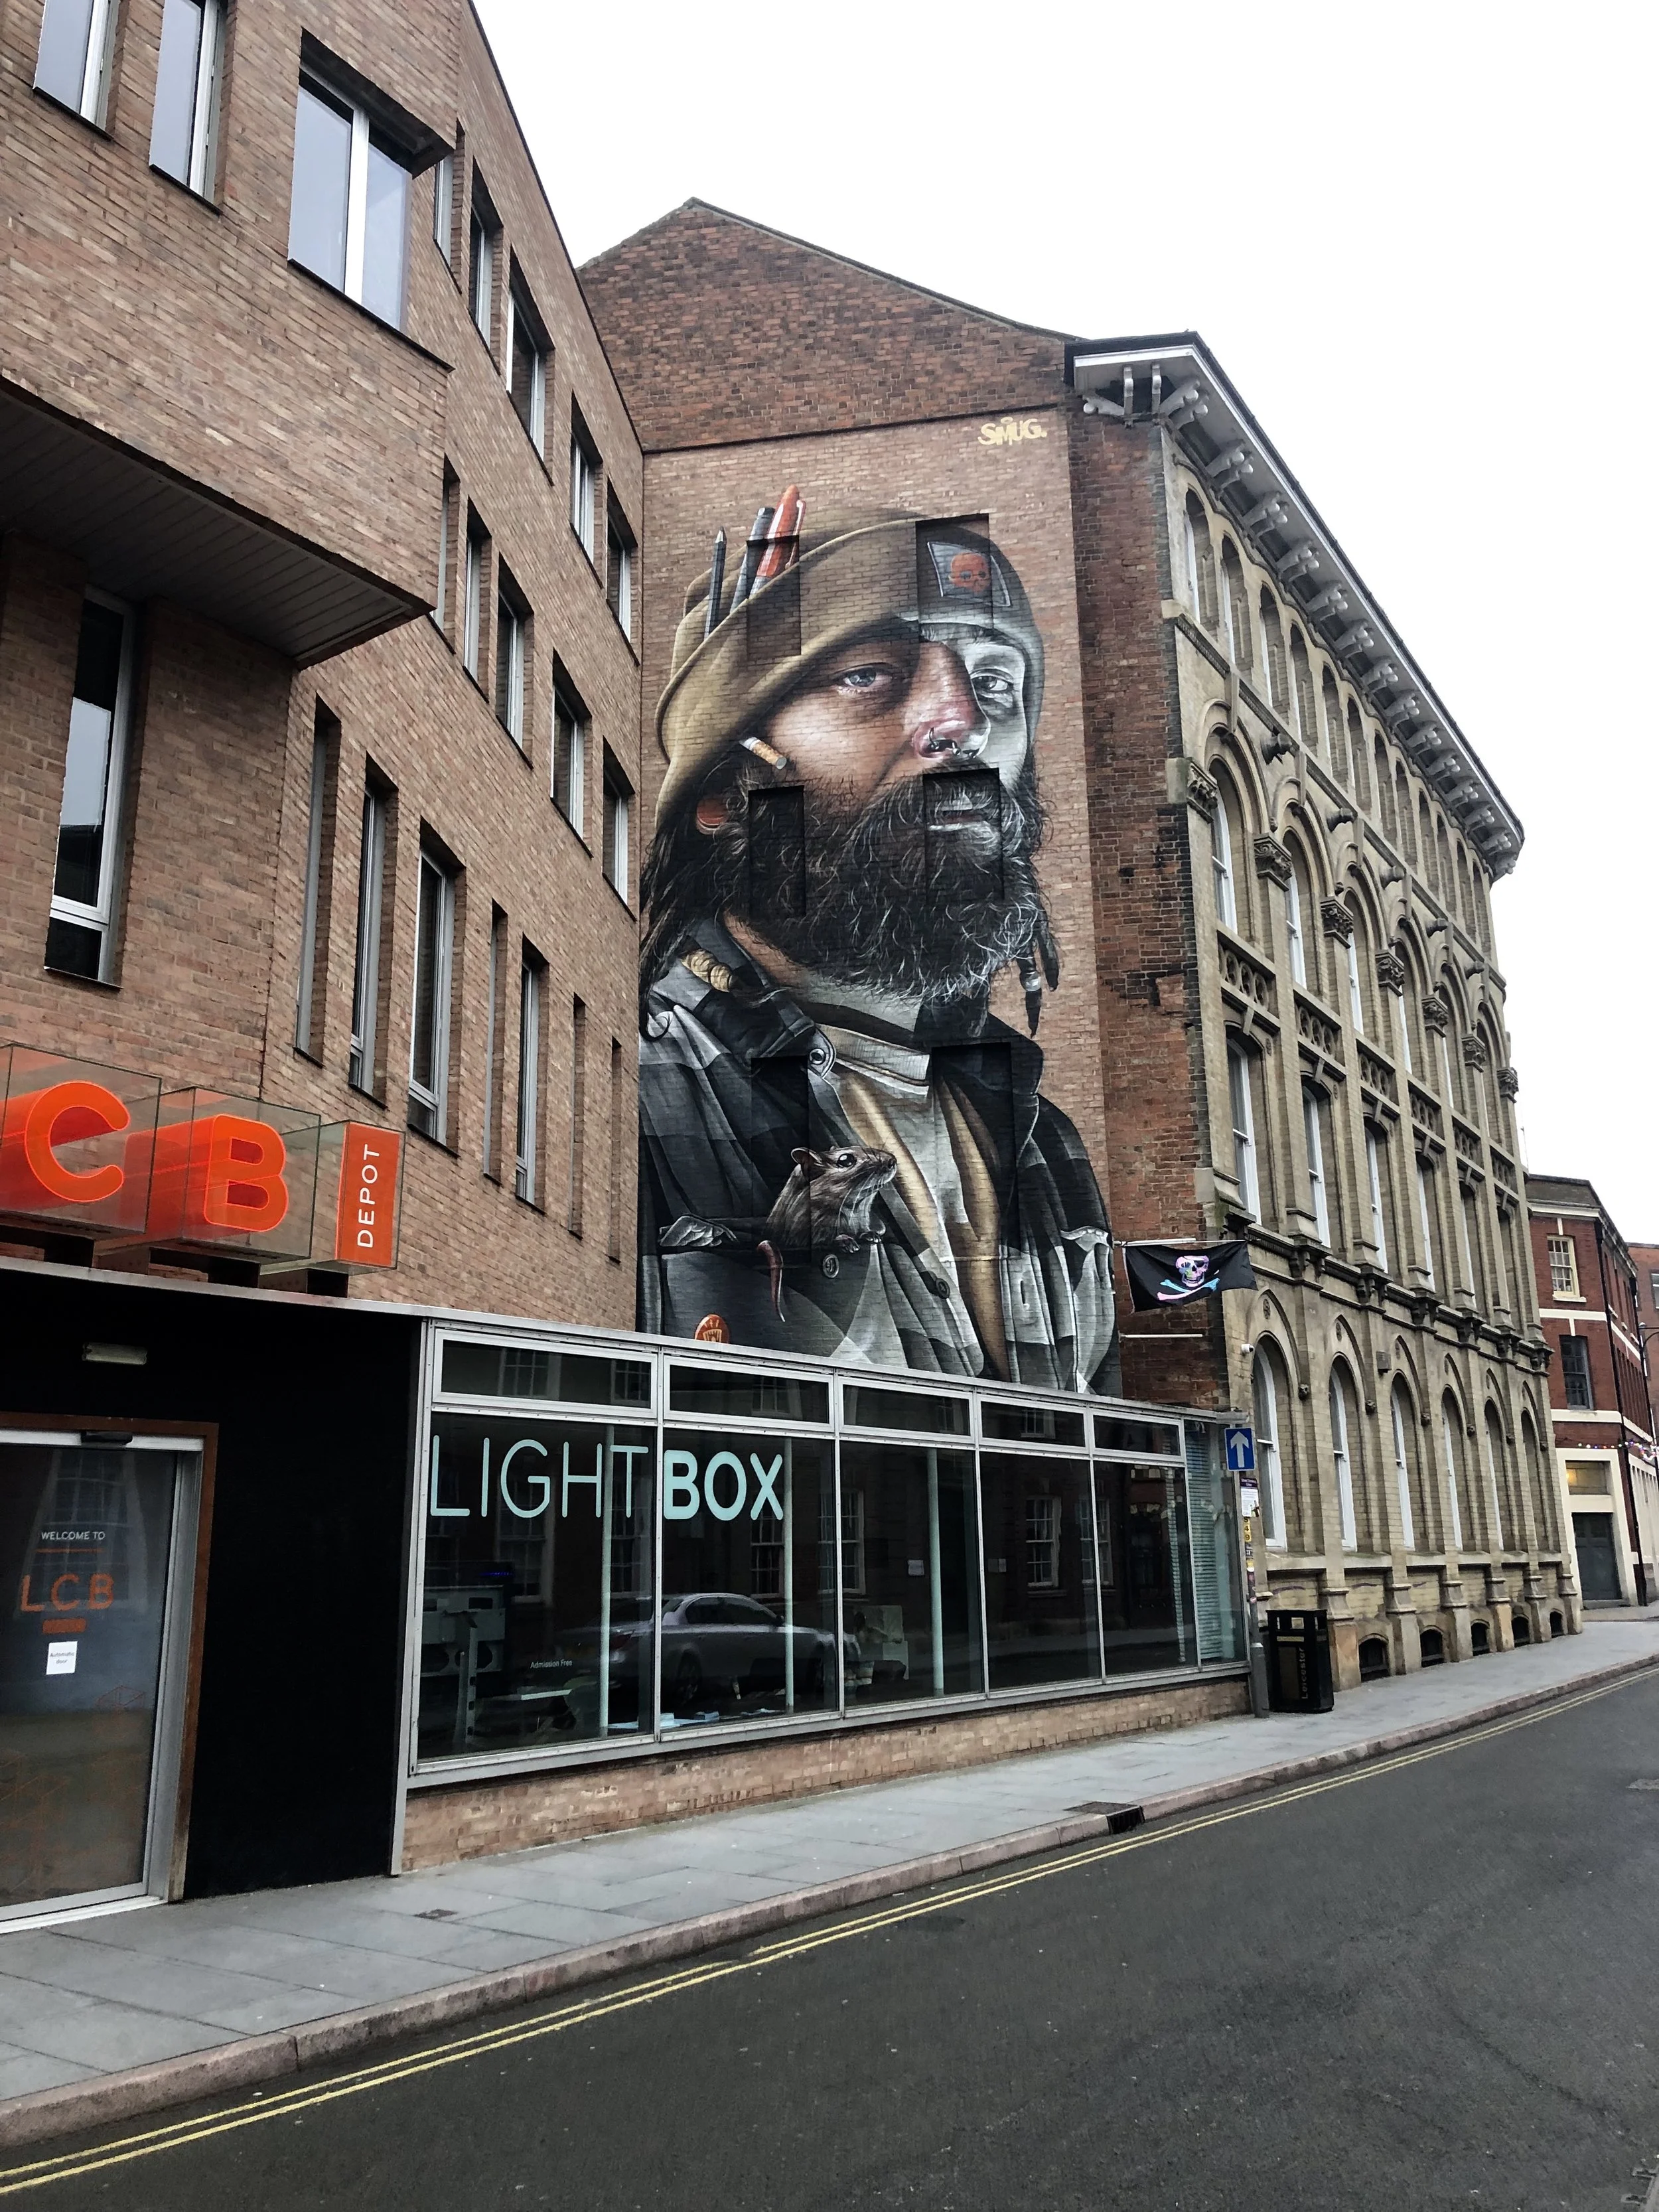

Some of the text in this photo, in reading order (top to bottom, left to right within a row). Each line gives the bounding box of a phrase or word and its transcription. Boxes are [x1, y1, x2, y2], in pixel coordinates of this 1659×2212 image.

[357, 1143, 380, 1248] DEPOT
[41, 1531, 106, 1540] WELCOME TO
[21, 1574, 114, 1611] LCB
[1299, 1647, 1309, 1699] Leicester
